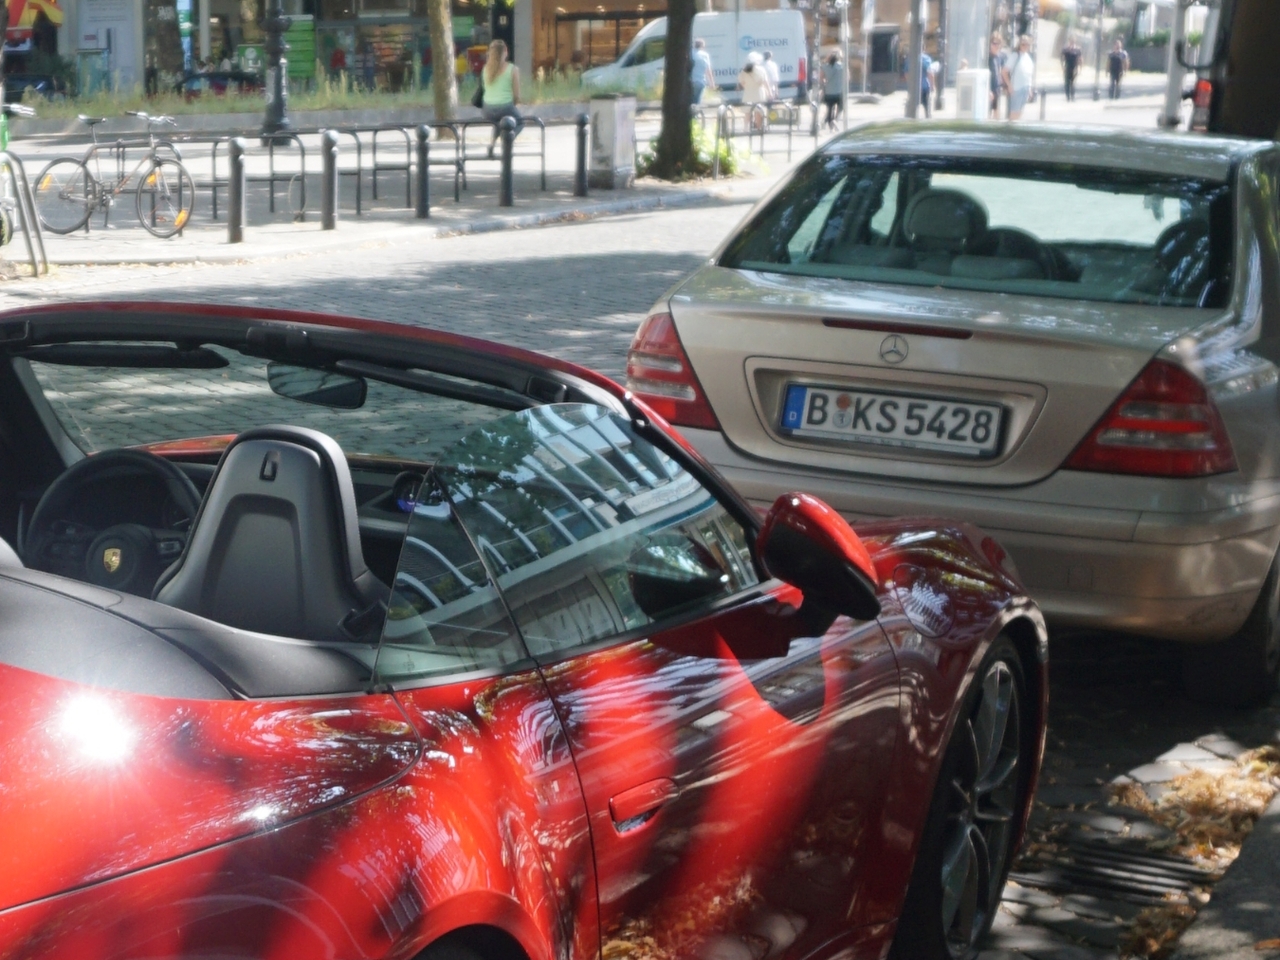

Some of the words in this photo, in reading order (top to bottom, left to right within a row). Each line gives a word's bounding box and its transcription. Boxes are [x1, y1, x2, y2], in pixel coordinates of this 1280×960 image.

[806, 392, 829, 426] B
[851, 397, 898, 434] KS
[904, 402, 994, 444] 5428
